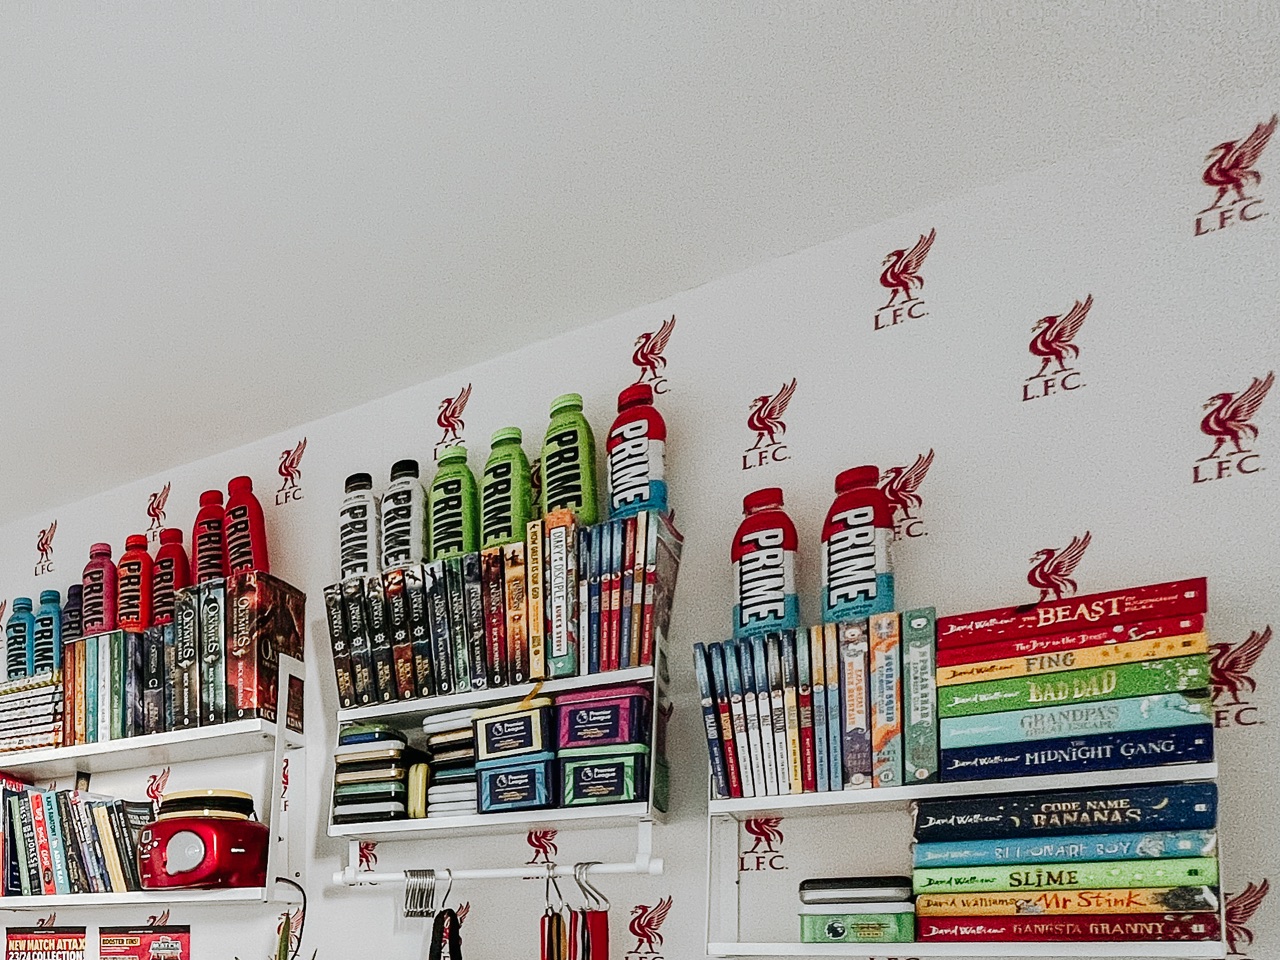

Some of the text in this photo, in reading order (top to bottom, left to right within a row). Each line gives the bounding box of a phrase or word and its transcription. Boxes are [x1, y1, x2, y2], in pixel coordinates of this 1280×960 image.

[545, 429, 583, 514] PRIME
[610, 418, 650, 510] PRIME
[433, 479, 463, 562] PRIME
[483, 462, 512, 546] PRIME
[225, 505, 254, 572] PRIME
[340, 504, 368, 580] PRIME
[383, 489, 412, 566] PRIME
[531, 531, 539, 545] HOW
[552, 531, 564, 555] DIARY
[198, 519, 223, 583] PRIME
[531, 546, 539, 565] GREAT
[829, 505, 877, 606] PRIME
[120, 561, 141, 627] PRIME
[154, 558, 175, 624] PRIME
[531, 573, 539, 586] OUR
[531, 587, 539, 600] GOD
[552, 565, 564, 602] DISCIPLE
[741, 528, 785, 625] PRIME
[83, 569, 104, 635] PRIME
[1037, 596, 1126, 629] BEAST
[182, 609, 194, 659] OLYMPUS
[207, 603, 220, 653] OLYMPUS
[236, 596, 250, 648] OLYMPUS
[7, 622, 27, 680] PRIME
[34, 616, 54, 675] PRIME
[1024, 651, 1077, 673] FING
[1026, 668, 1117, 703] BAD DAD
[1120, 739, 1175, 760] GANG
[48, 811, 57, 837] ANATOMY
[1032, 809, 1143, 828] BANANAS
[1041, 799, 1131, 813] CODE NAME
[27, 838, 38, 863] JOKES
[53, 850, 62, 870] ADAM
[56, 870, 65, 885] KAY
[1077, 890, 1147, 910] Stink
[8, 938, 86, 951] NEW MATCH ATTAX
[1089, 922, 1166, 935] GRANNY
